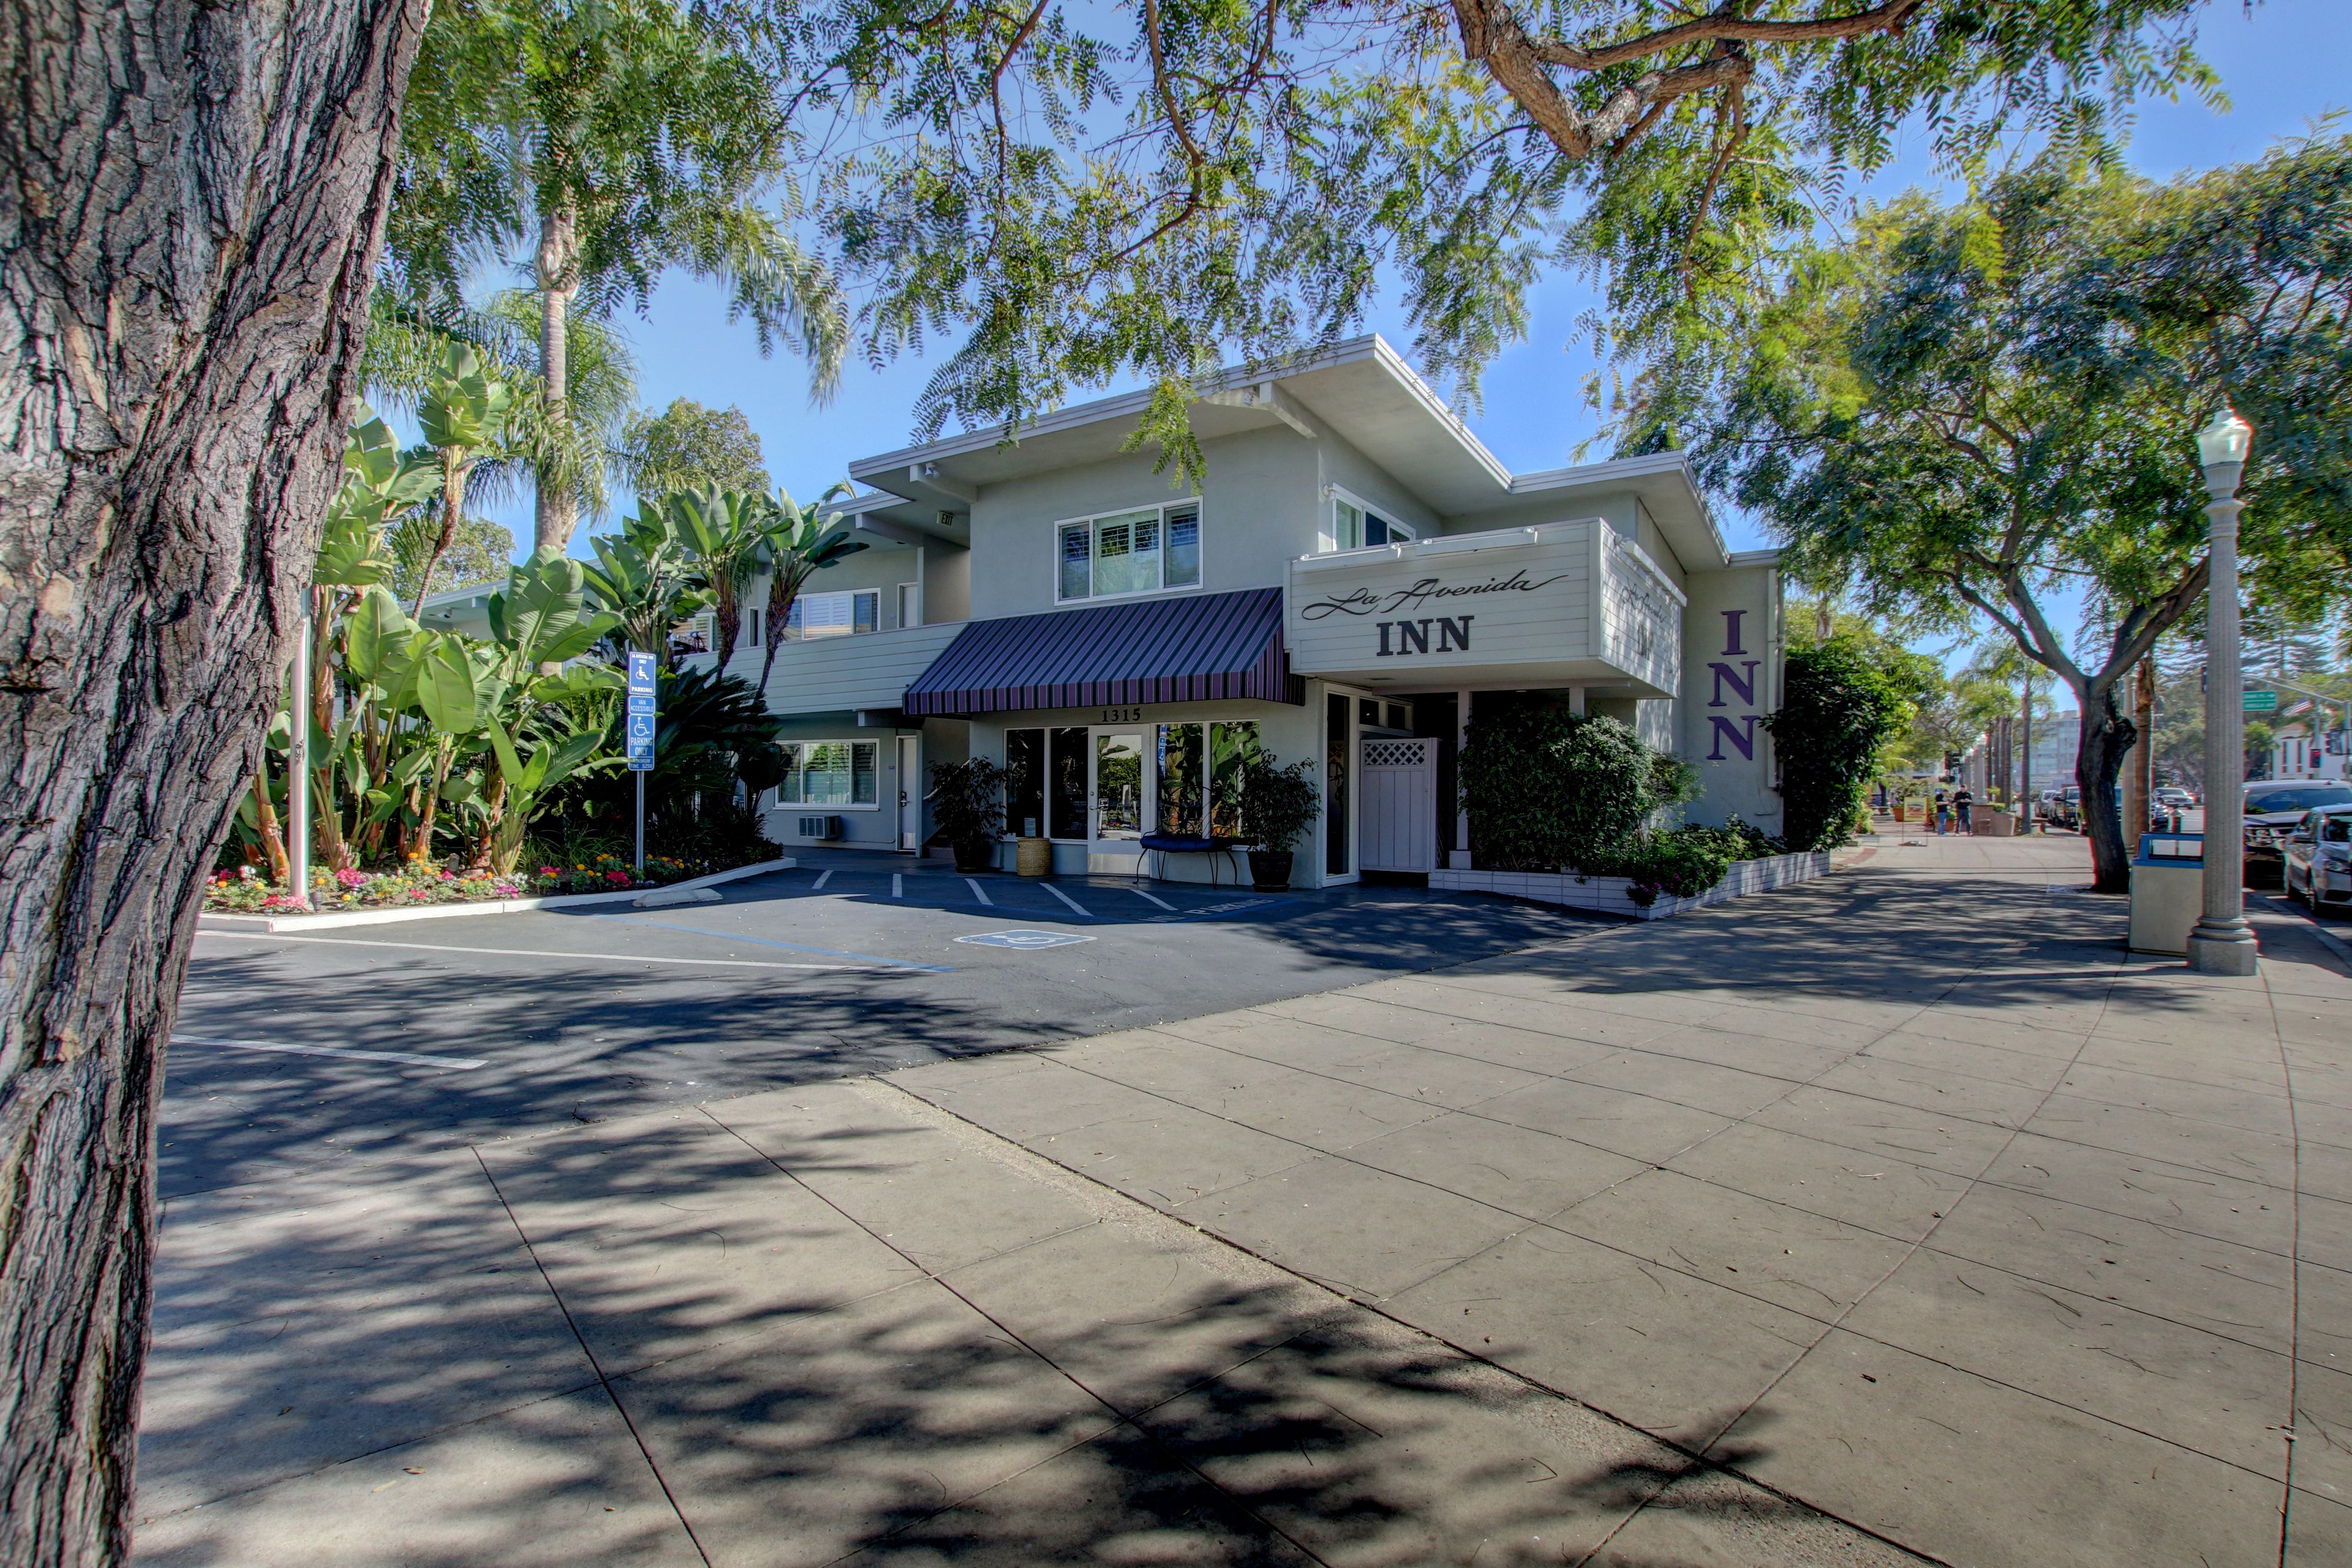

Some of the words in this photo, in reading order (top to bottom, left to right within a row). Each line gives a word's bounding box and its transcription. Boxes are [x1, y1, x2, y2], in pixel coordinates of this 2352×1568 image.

[941, 513, 954, 527] EXIT
[1302, 588, 1378, 620] La
[1381, 569, 1569, 613] Avenida
[1376, 616, 1474, 656] INN
[1706, 609, 1761, 761] INN
[1102, 707, 1141, 722] 1315
[630, 737, 652, 746] PARKING
[635, 747, 648, 756] ONLY
